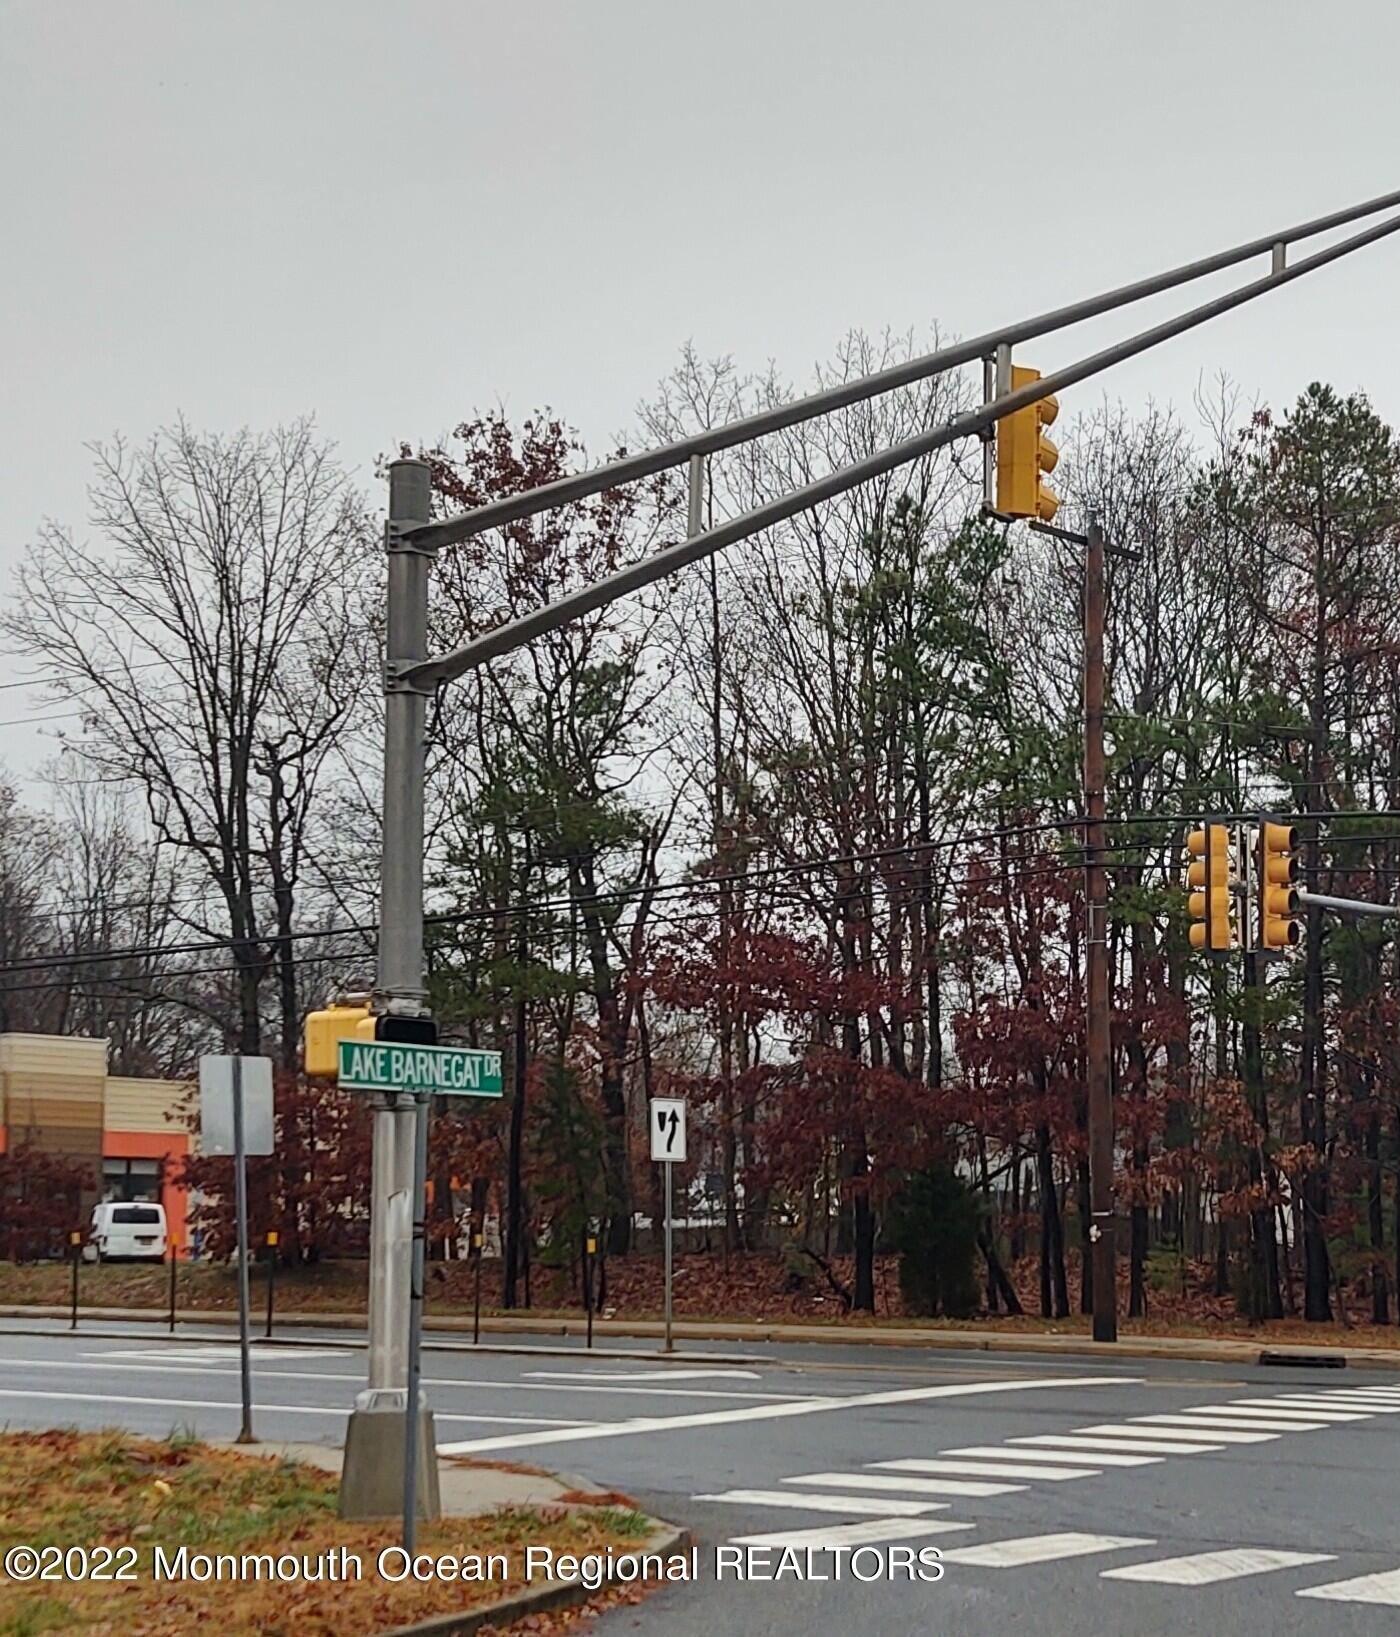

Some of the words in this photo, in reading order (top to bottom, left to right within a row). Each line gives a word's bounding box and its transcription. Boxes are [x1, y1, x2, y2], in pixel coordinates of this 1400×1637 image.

[339, 1046, 388, 1082] LAKE
[391, 1050, 482, 1088] BARNEGAT
[484, 1055, 502, 1077] DR
